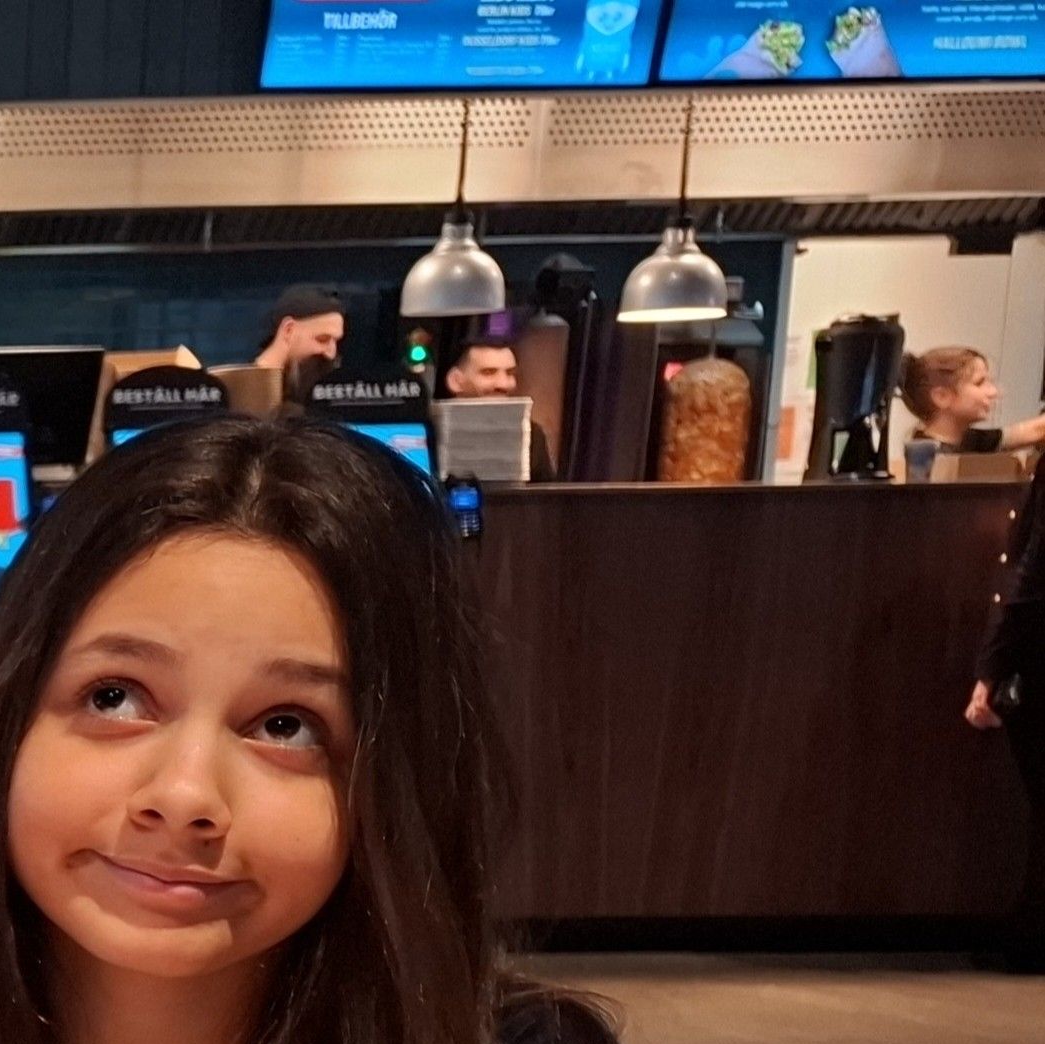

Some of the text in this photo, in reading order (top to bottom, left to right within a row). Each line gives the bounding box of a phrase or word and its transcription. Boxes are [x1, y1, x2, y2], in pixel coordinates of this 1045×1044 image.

[323, 8, 398, 30] TILLBEHÖR
[113, 384, 222, 404] BESTÄLL HÄR
[313, 379, 421, 400] BESTÄLL HÄR
